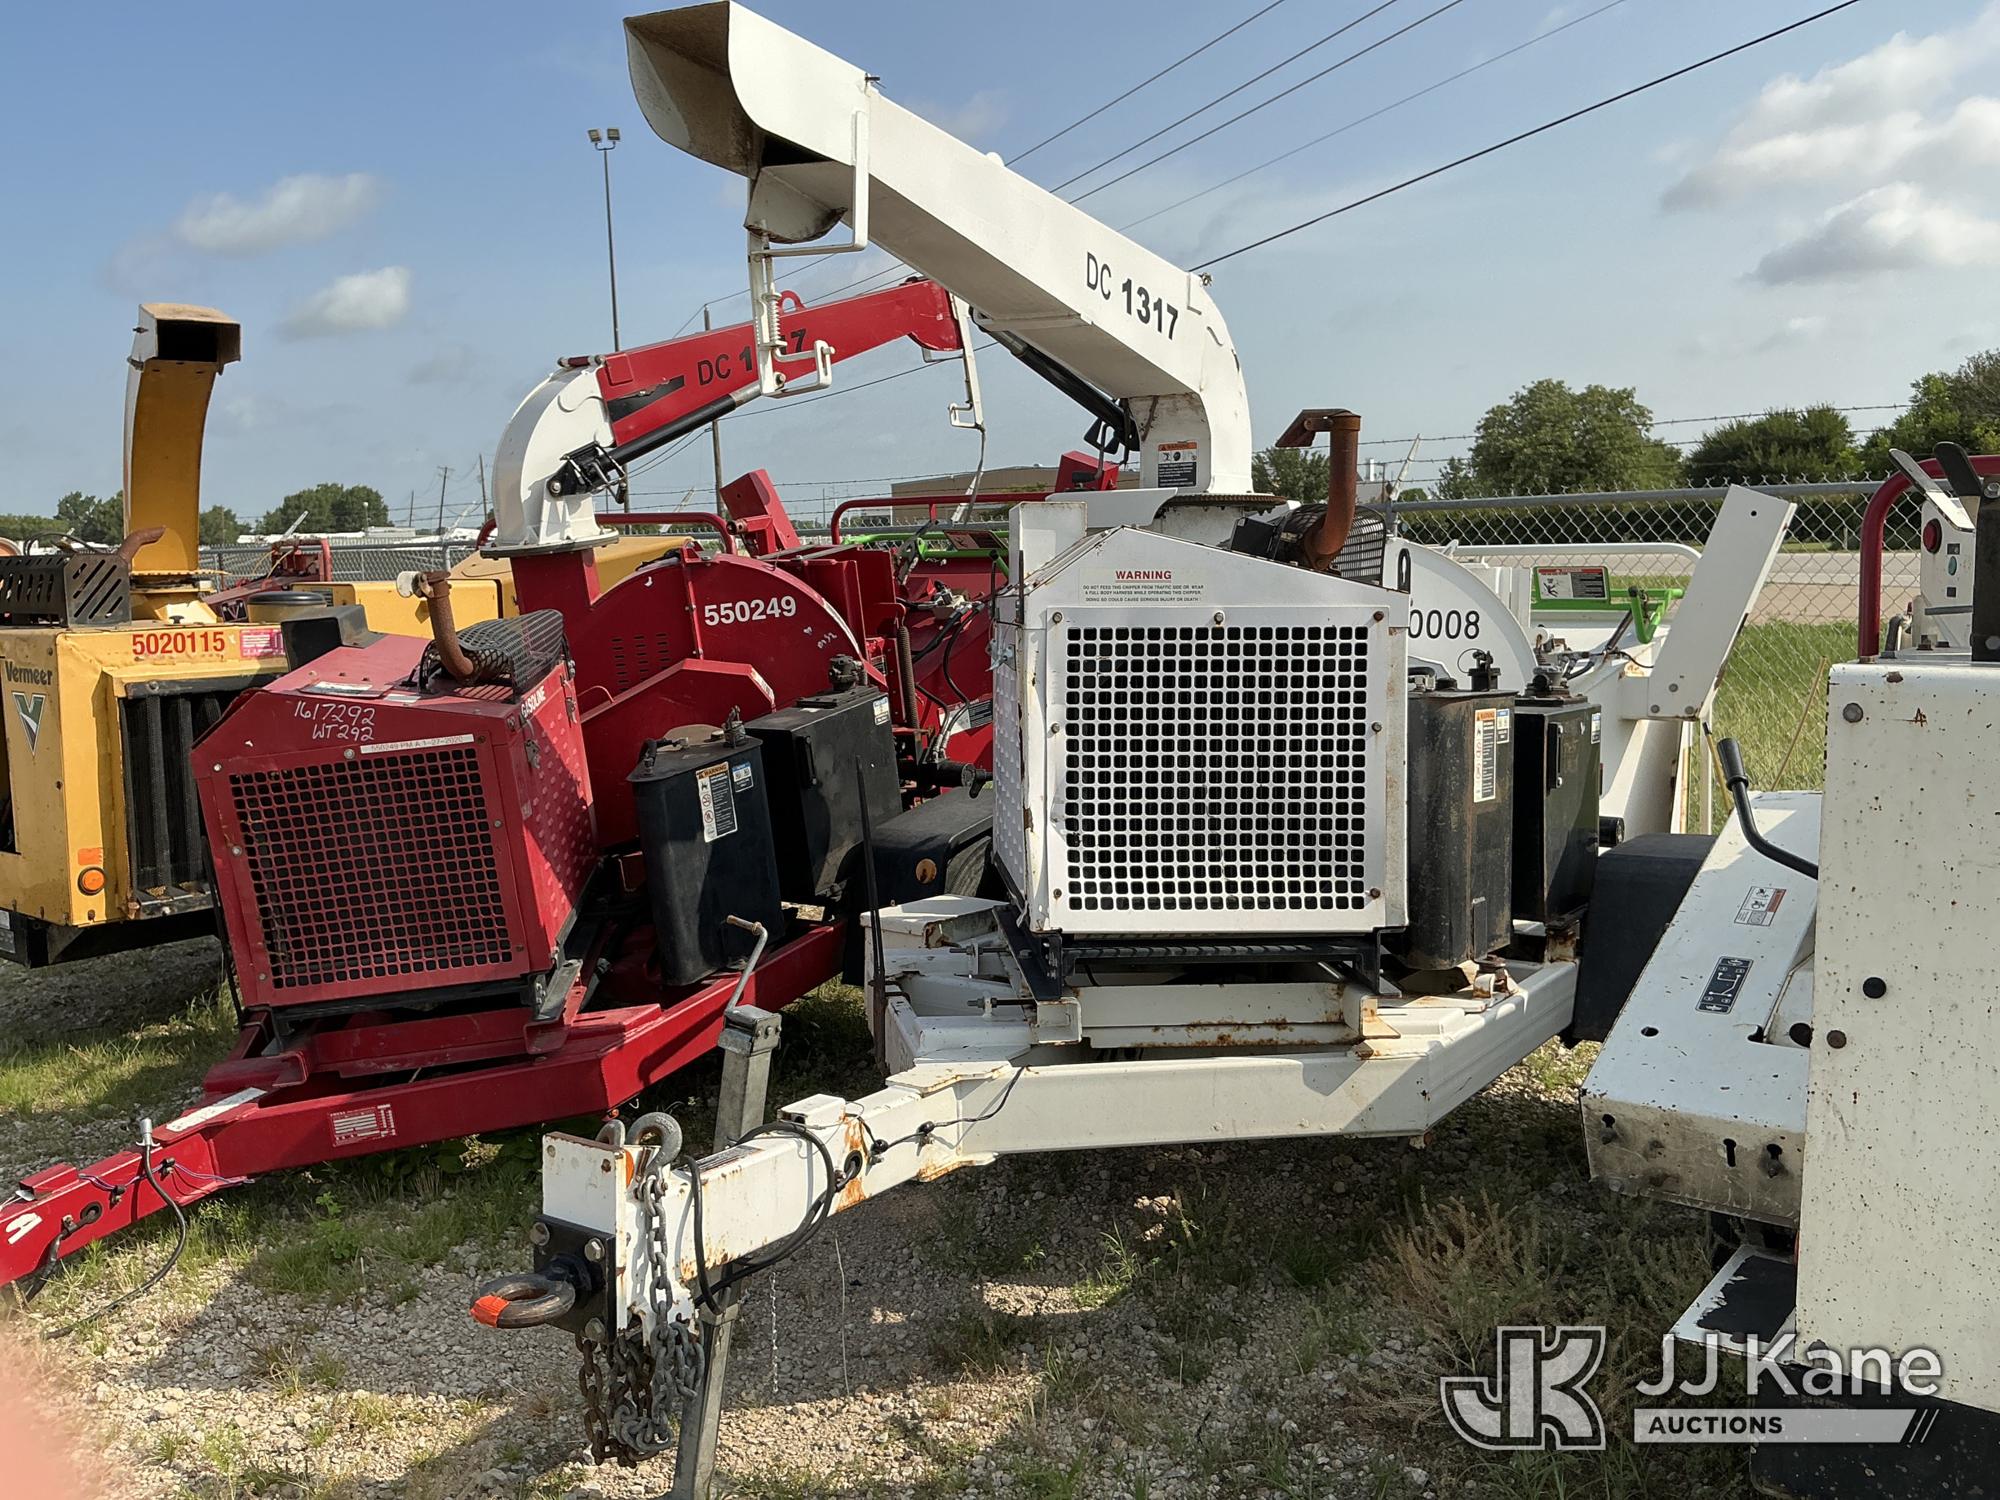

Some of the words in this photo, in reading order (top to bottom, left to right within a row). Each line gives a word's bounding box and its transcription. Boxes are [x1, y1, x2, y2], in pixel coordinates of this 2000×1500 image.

[1086, 252, 1112, 300] DC
[1122, 278, 1179, 341] 1317
[697, 353, 731, 386] DC
[1115, 570, 1172, 580] WARNING
[704, 595, 797, 626] 550249
[132, 631, 225, 655] 5020115
[5, 660, 53, 686] Vermeer
[294, 700, 376, 726] 1617292
[521, 686, 546, 718] GASOLINE
[312, 724, 375, 742] WT292
